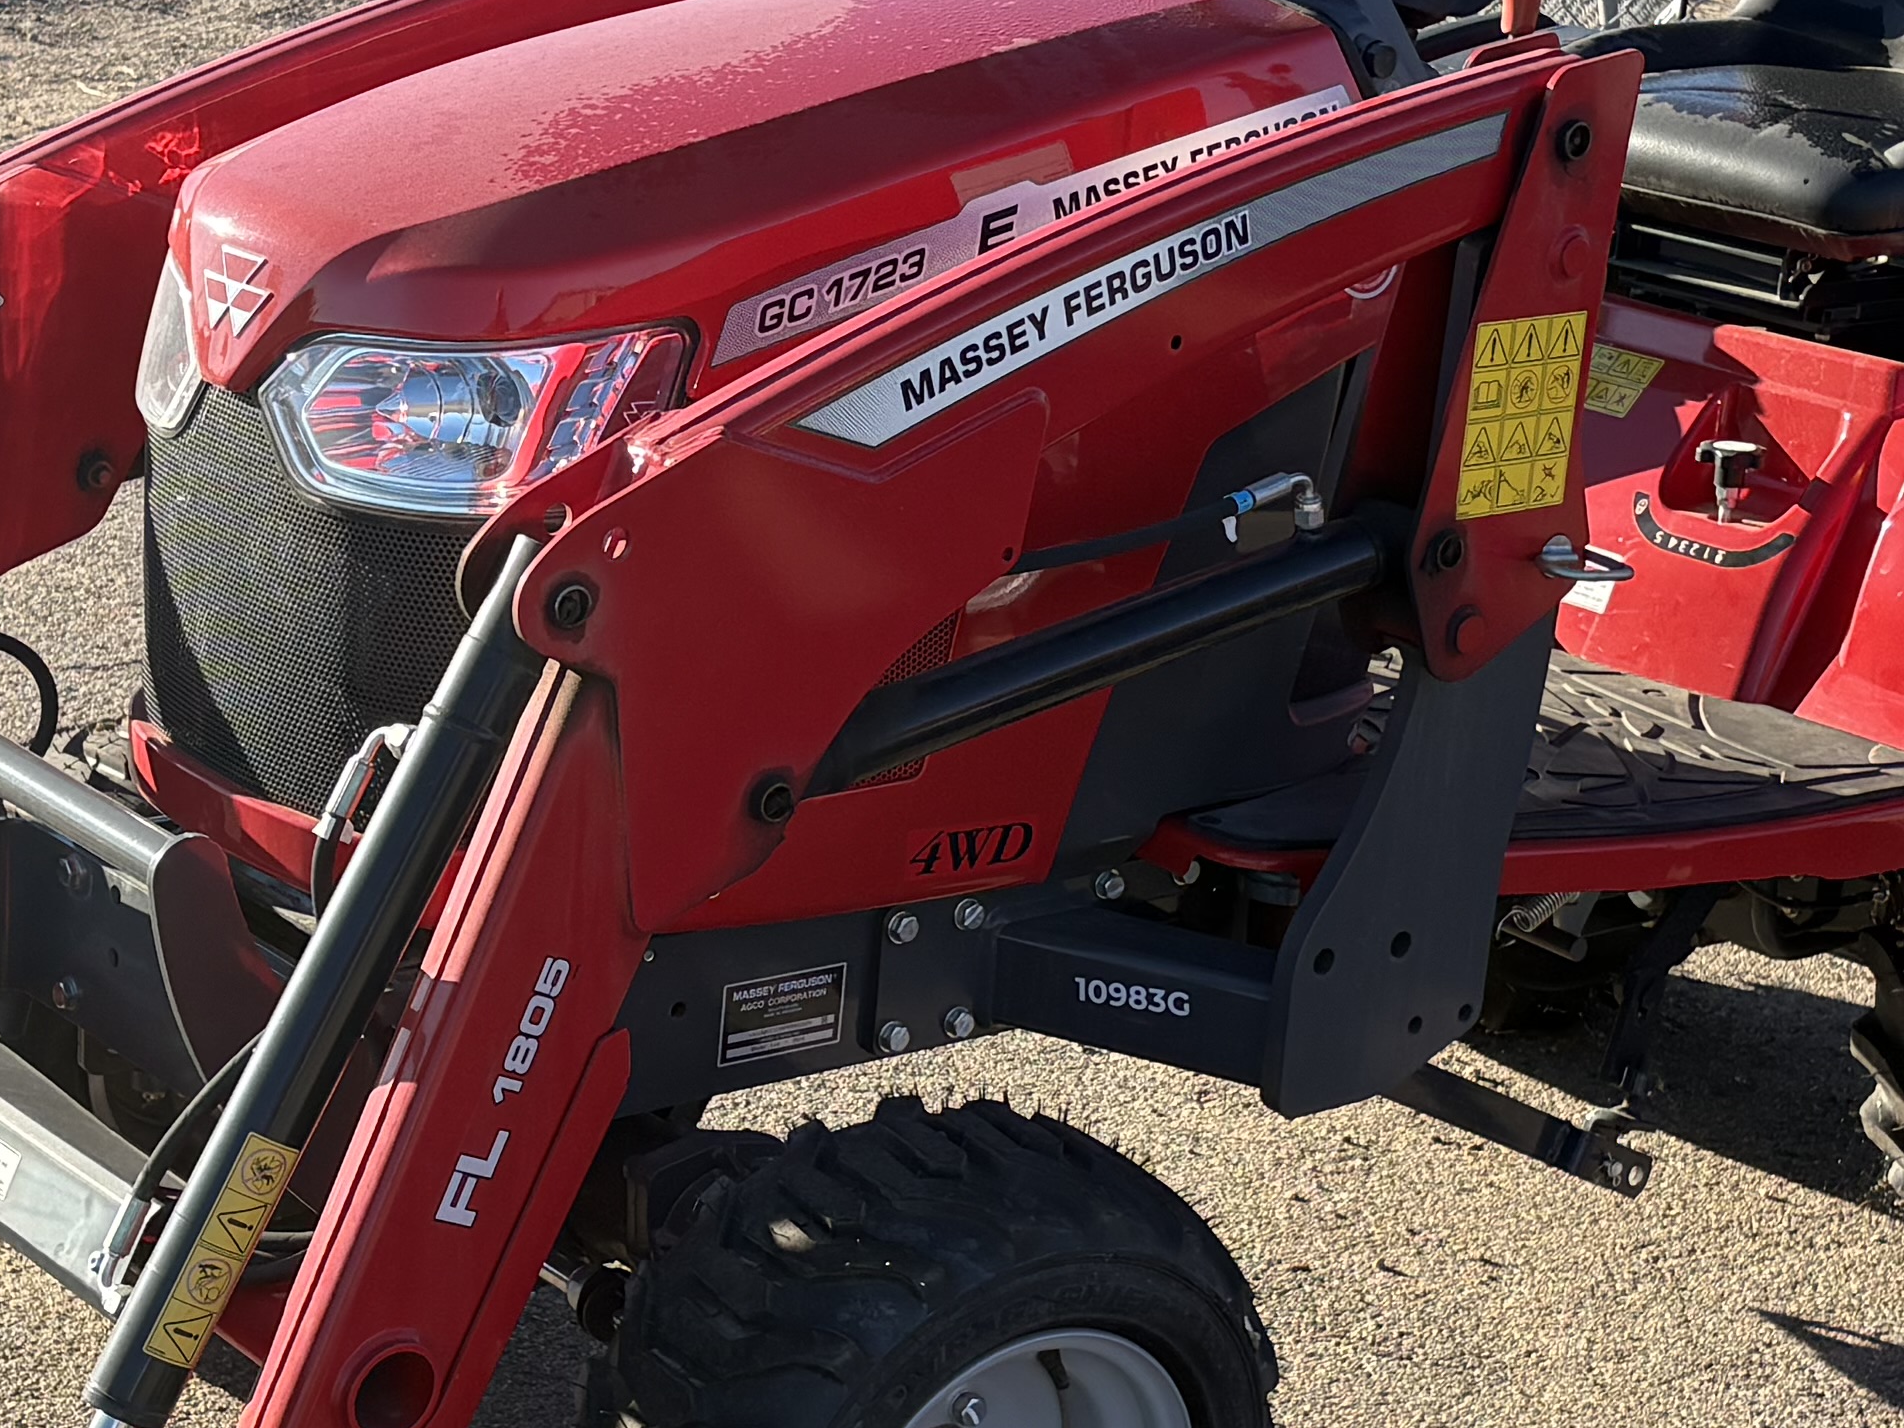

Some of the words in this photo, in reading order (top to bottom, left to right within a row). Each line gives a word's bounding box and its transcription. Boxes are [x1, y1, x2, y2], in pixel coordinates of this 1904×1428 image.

[758, 287, 815, 334] GC
[824, 247, 927, 309] 1723
[899, 304, 1050, 412] MASSEY
[1063, 211, 1250, 327] FERGUSON
[909, 822, 1033, 876] 4WD
[732, 984, 777, 1002] MASSEY
[777, 973, 833, 993] FERGUSON
[1075, 977, 1190, 1016] 10983G
[435, 1130, 510, 1228] FL
[493, 956, 570, 1104] 1805
